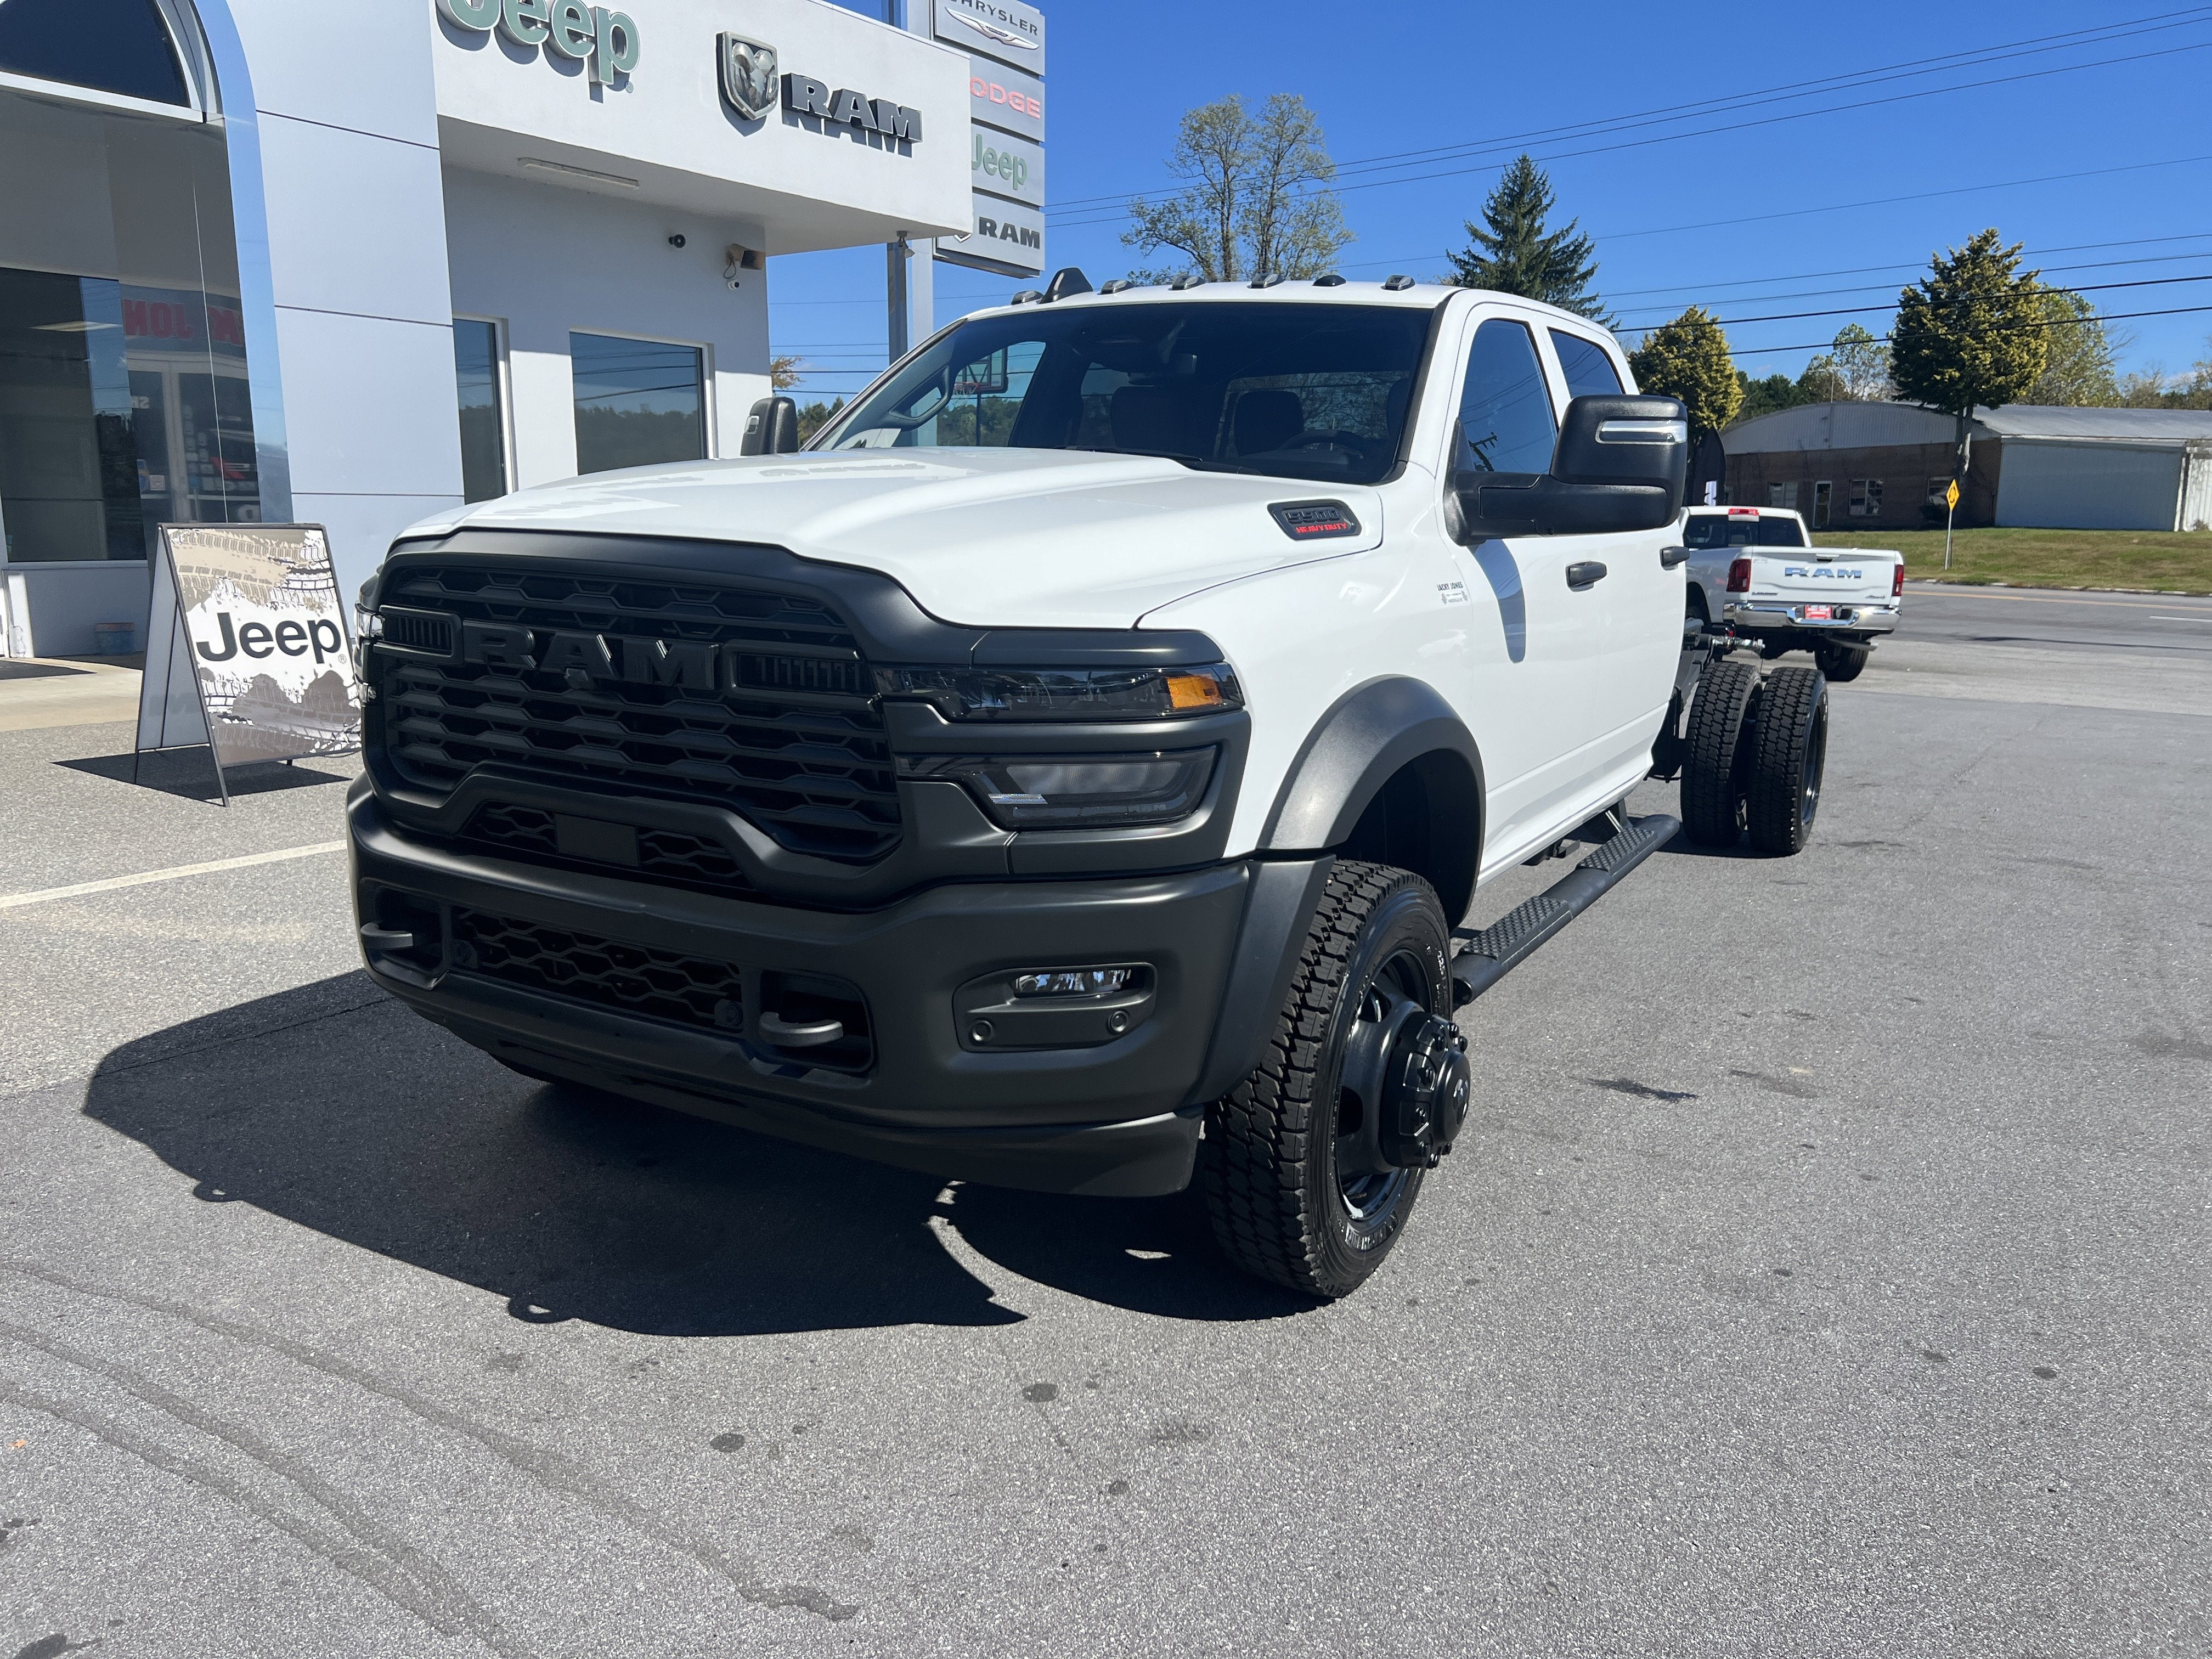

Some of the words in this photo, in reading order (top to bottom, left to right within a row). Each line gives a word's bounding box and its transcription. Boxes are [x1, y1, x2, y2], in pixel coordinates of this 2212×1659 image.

[950, 0, 1038, 36] HRYSLER
[781, 72, 923, 143] RAM
[969, 76, 1040, 120] ODGE
[971, 134, 1028, 190] Jeep
[979, 216, 1040, 250] RAM
[1285, 509, 1341, 524] 5500
[1295, 525, 1325, 534] HEAVY
[1784, 567, 1862, 579] RAM
[195, 612, 341, 664] Jeep
[464, 621, 720, 691] RAM
